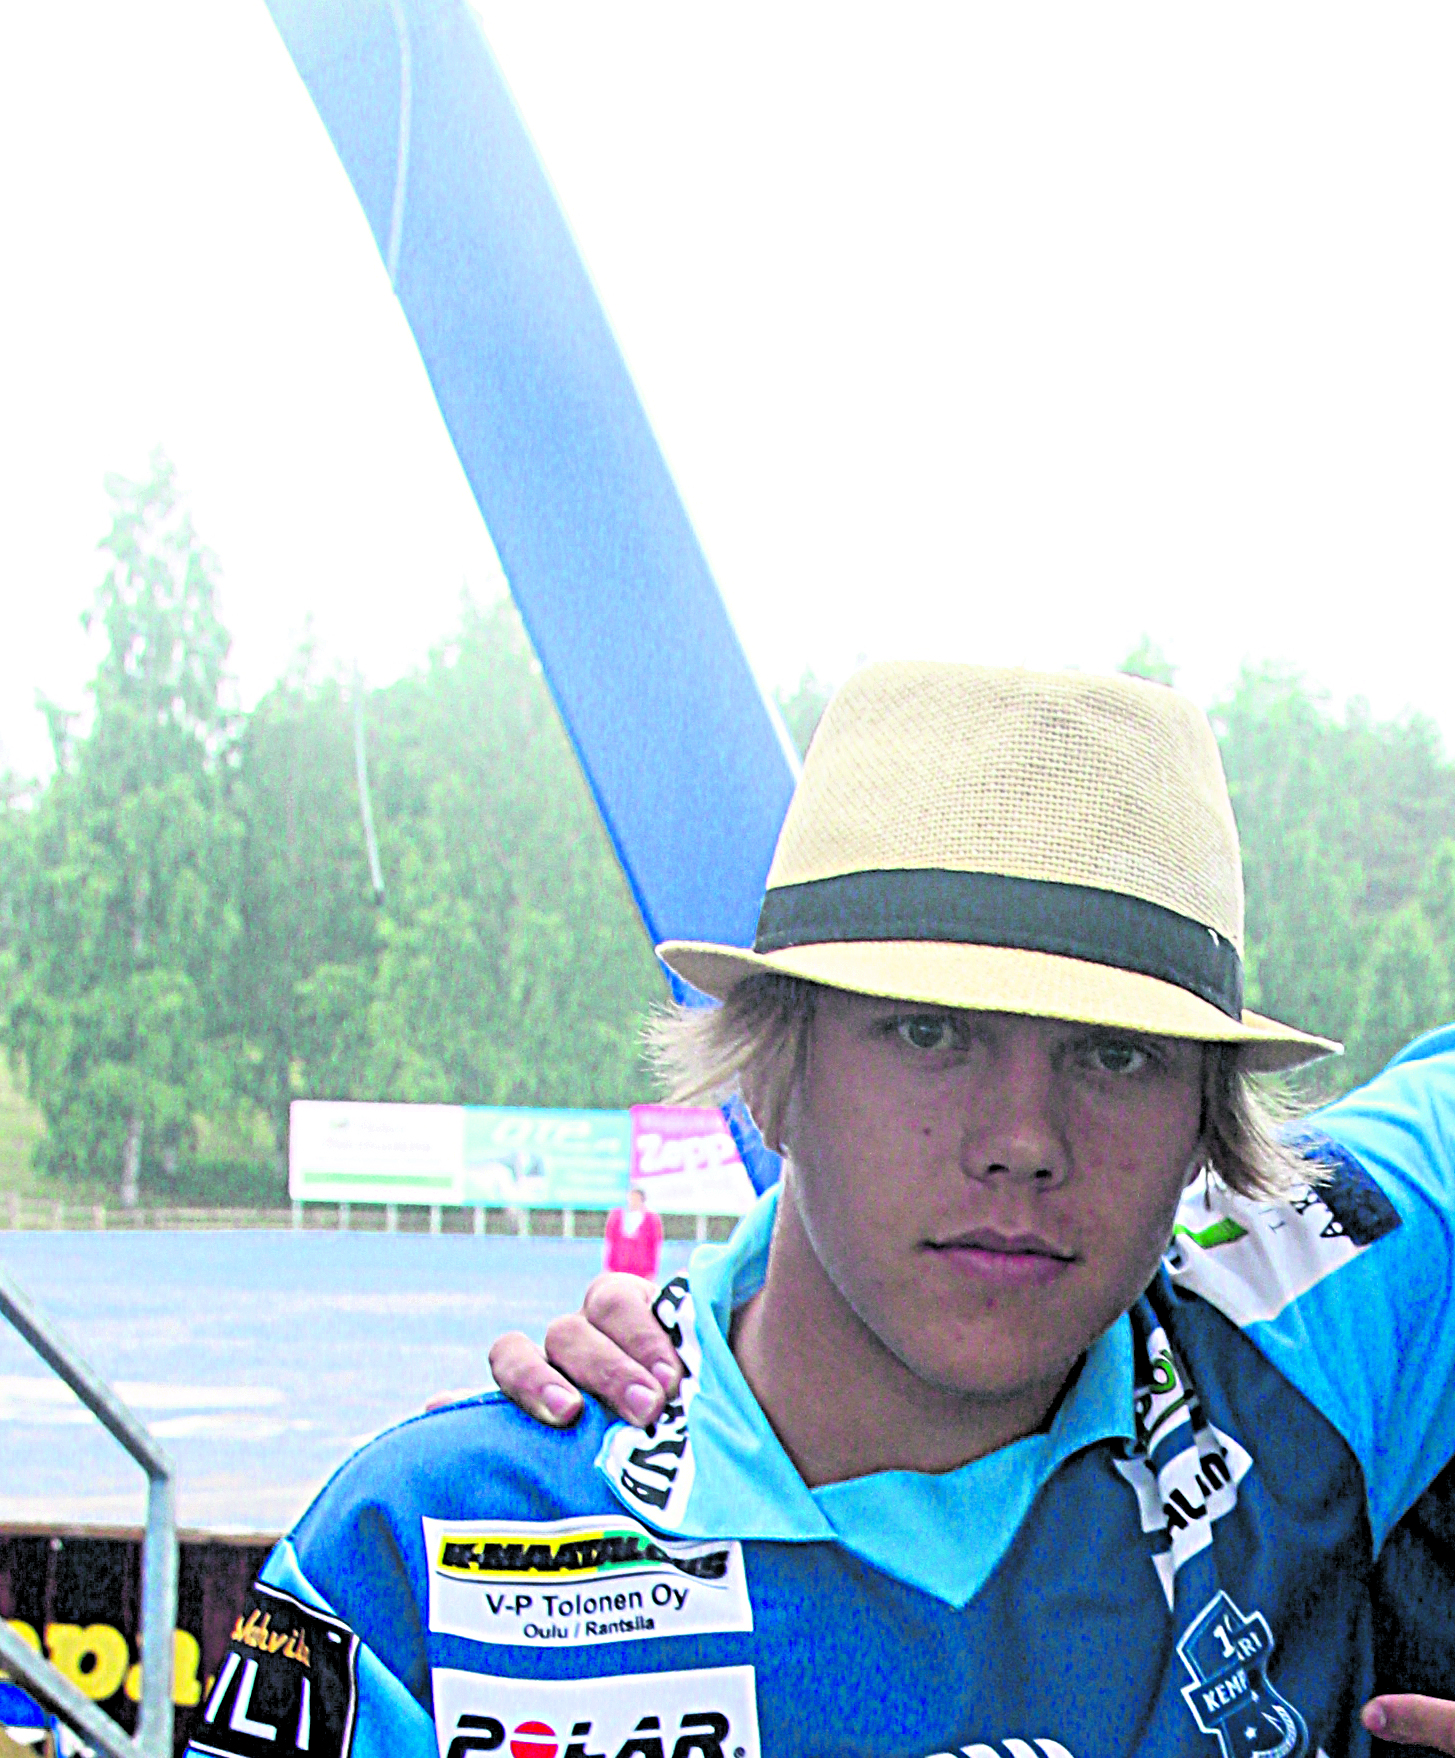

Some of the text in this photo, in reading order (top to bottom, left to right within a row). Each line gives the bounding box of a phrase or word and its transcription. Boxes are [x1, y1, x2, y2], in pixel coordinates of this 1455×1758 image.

[485, 1583, 689, 1617] V-P Tolonen Oy
[523, 1623, 569, 1640] Oulu
